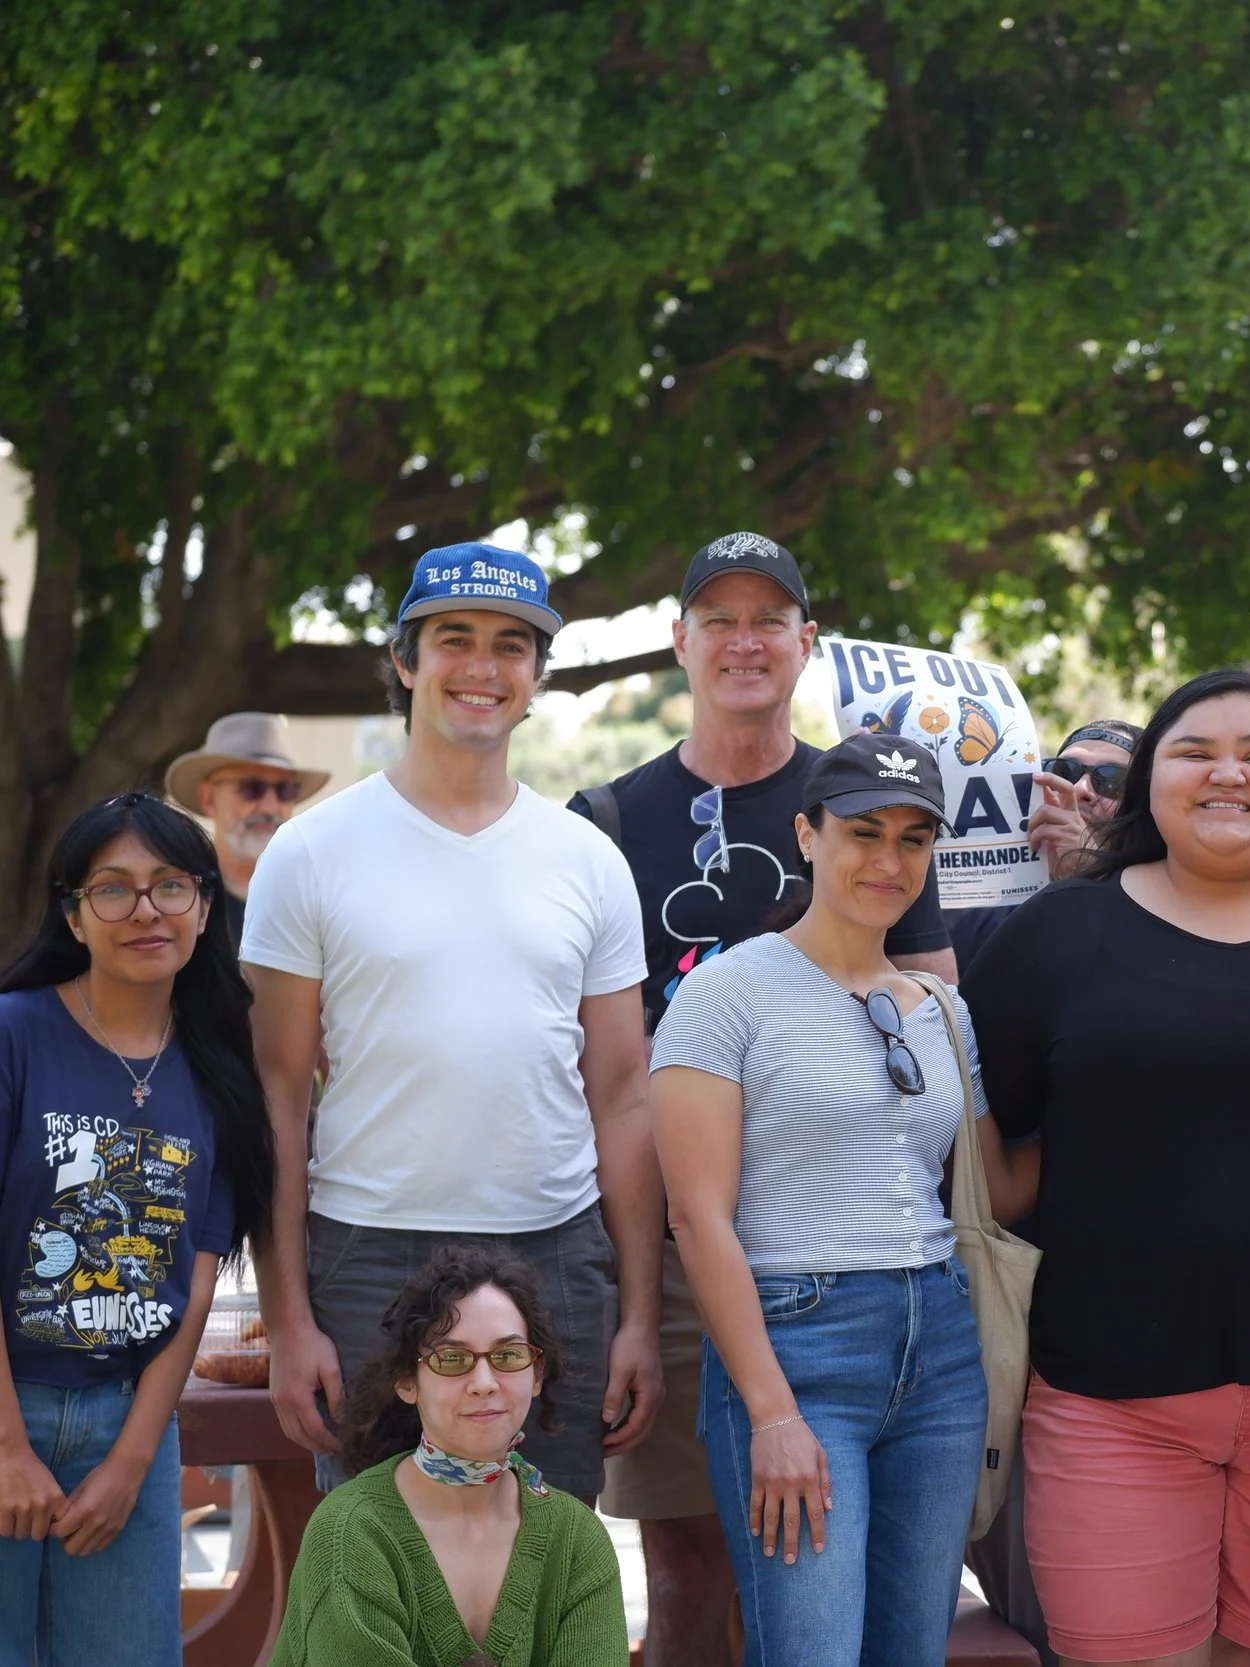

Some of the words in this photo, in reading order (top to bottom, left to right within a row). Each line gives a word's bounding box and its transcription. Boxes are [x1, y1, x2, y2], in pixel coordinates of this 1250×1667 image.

[426, 564, 462, 585] Los
[470, 560, 538, 592] Angeles
[450, 582, 518, 599] STRONG
[828, 642, 916, 708] ICE
[925, 653, 1016, 709] OUT
[878, 767, 921, 784] adidas
[953, 772, 1036, 838] A!
[939, 845, 1041, 869] HERNANDEZ
[939, 871, 953, 879] City
[981, 868, 1007, 876] District
[1001, 885, 1039, 895] EUNISSES
[94, 1115, 119, 1138] CD
[44, 1130, 100, 1194] #1
[153, 1169, 173, 1178] PARK
[81, 1330, 112, 1346] VOTE
